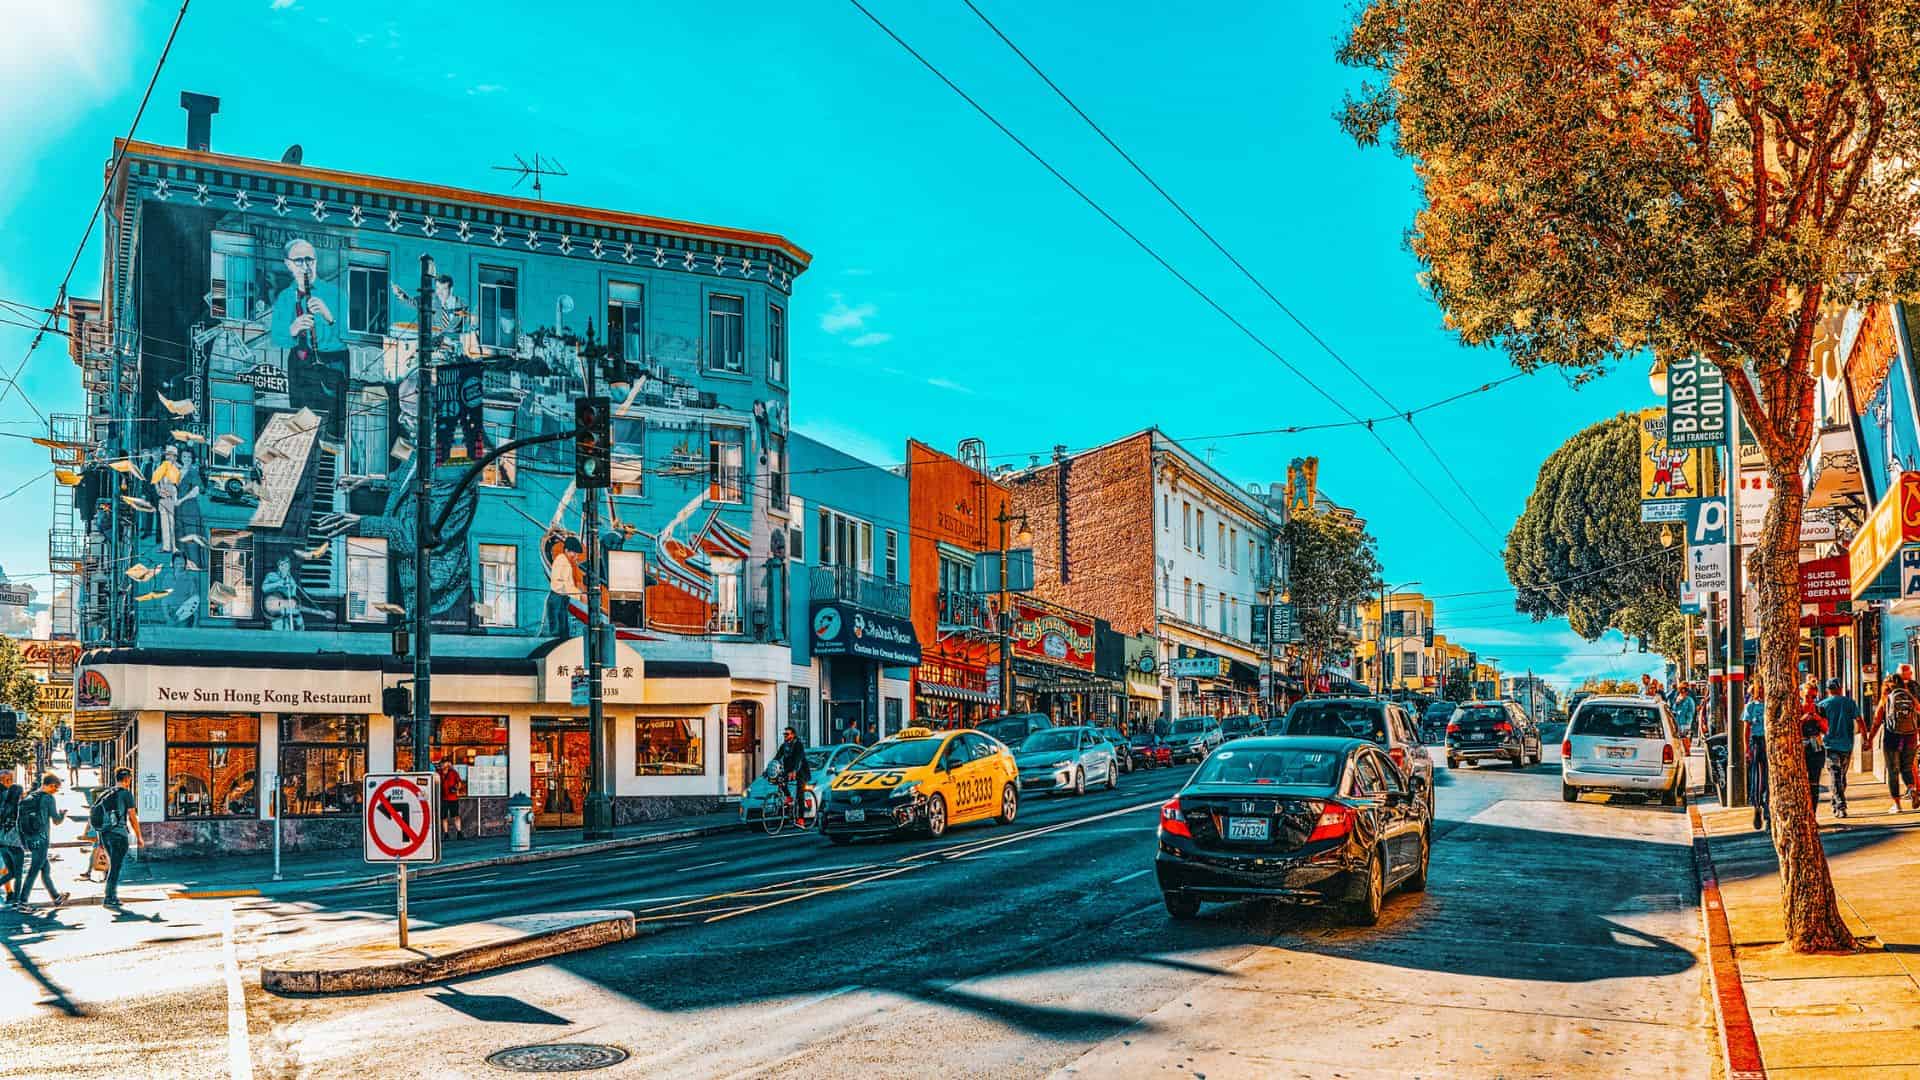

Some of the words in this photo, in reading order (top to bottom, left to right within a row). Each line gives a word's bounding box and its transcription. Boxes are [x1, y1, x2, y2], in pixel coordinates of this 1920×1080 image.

[1700, 357, 1724, 431] COLLE
[1672, 433, 1686, 442] SAN
[1687, 432, 1724, 442] FRANCISCO
[1695, 563, 1719, 571] North
[1695, 571, 1721, 580] Beach
[1808, 570, 1836, 580] SLICES
[1695, 580, 1726, 588] Garage
[1808, 580, 1823, 589] HOT
[1808, 589, 1830, 598] BEER
[44, 688, 73, 700] PIZ
[158, 687, 189, 701] New
[193, 688, 219, 702] Sun
[224, 689, 261, 705] Hong
[264, 690, 299, 706] Kong
[303, 690, 372, 704] Restaurant
[832, 770, 907, 789] 1575
[956, 776, 992, 806] 333-3333
